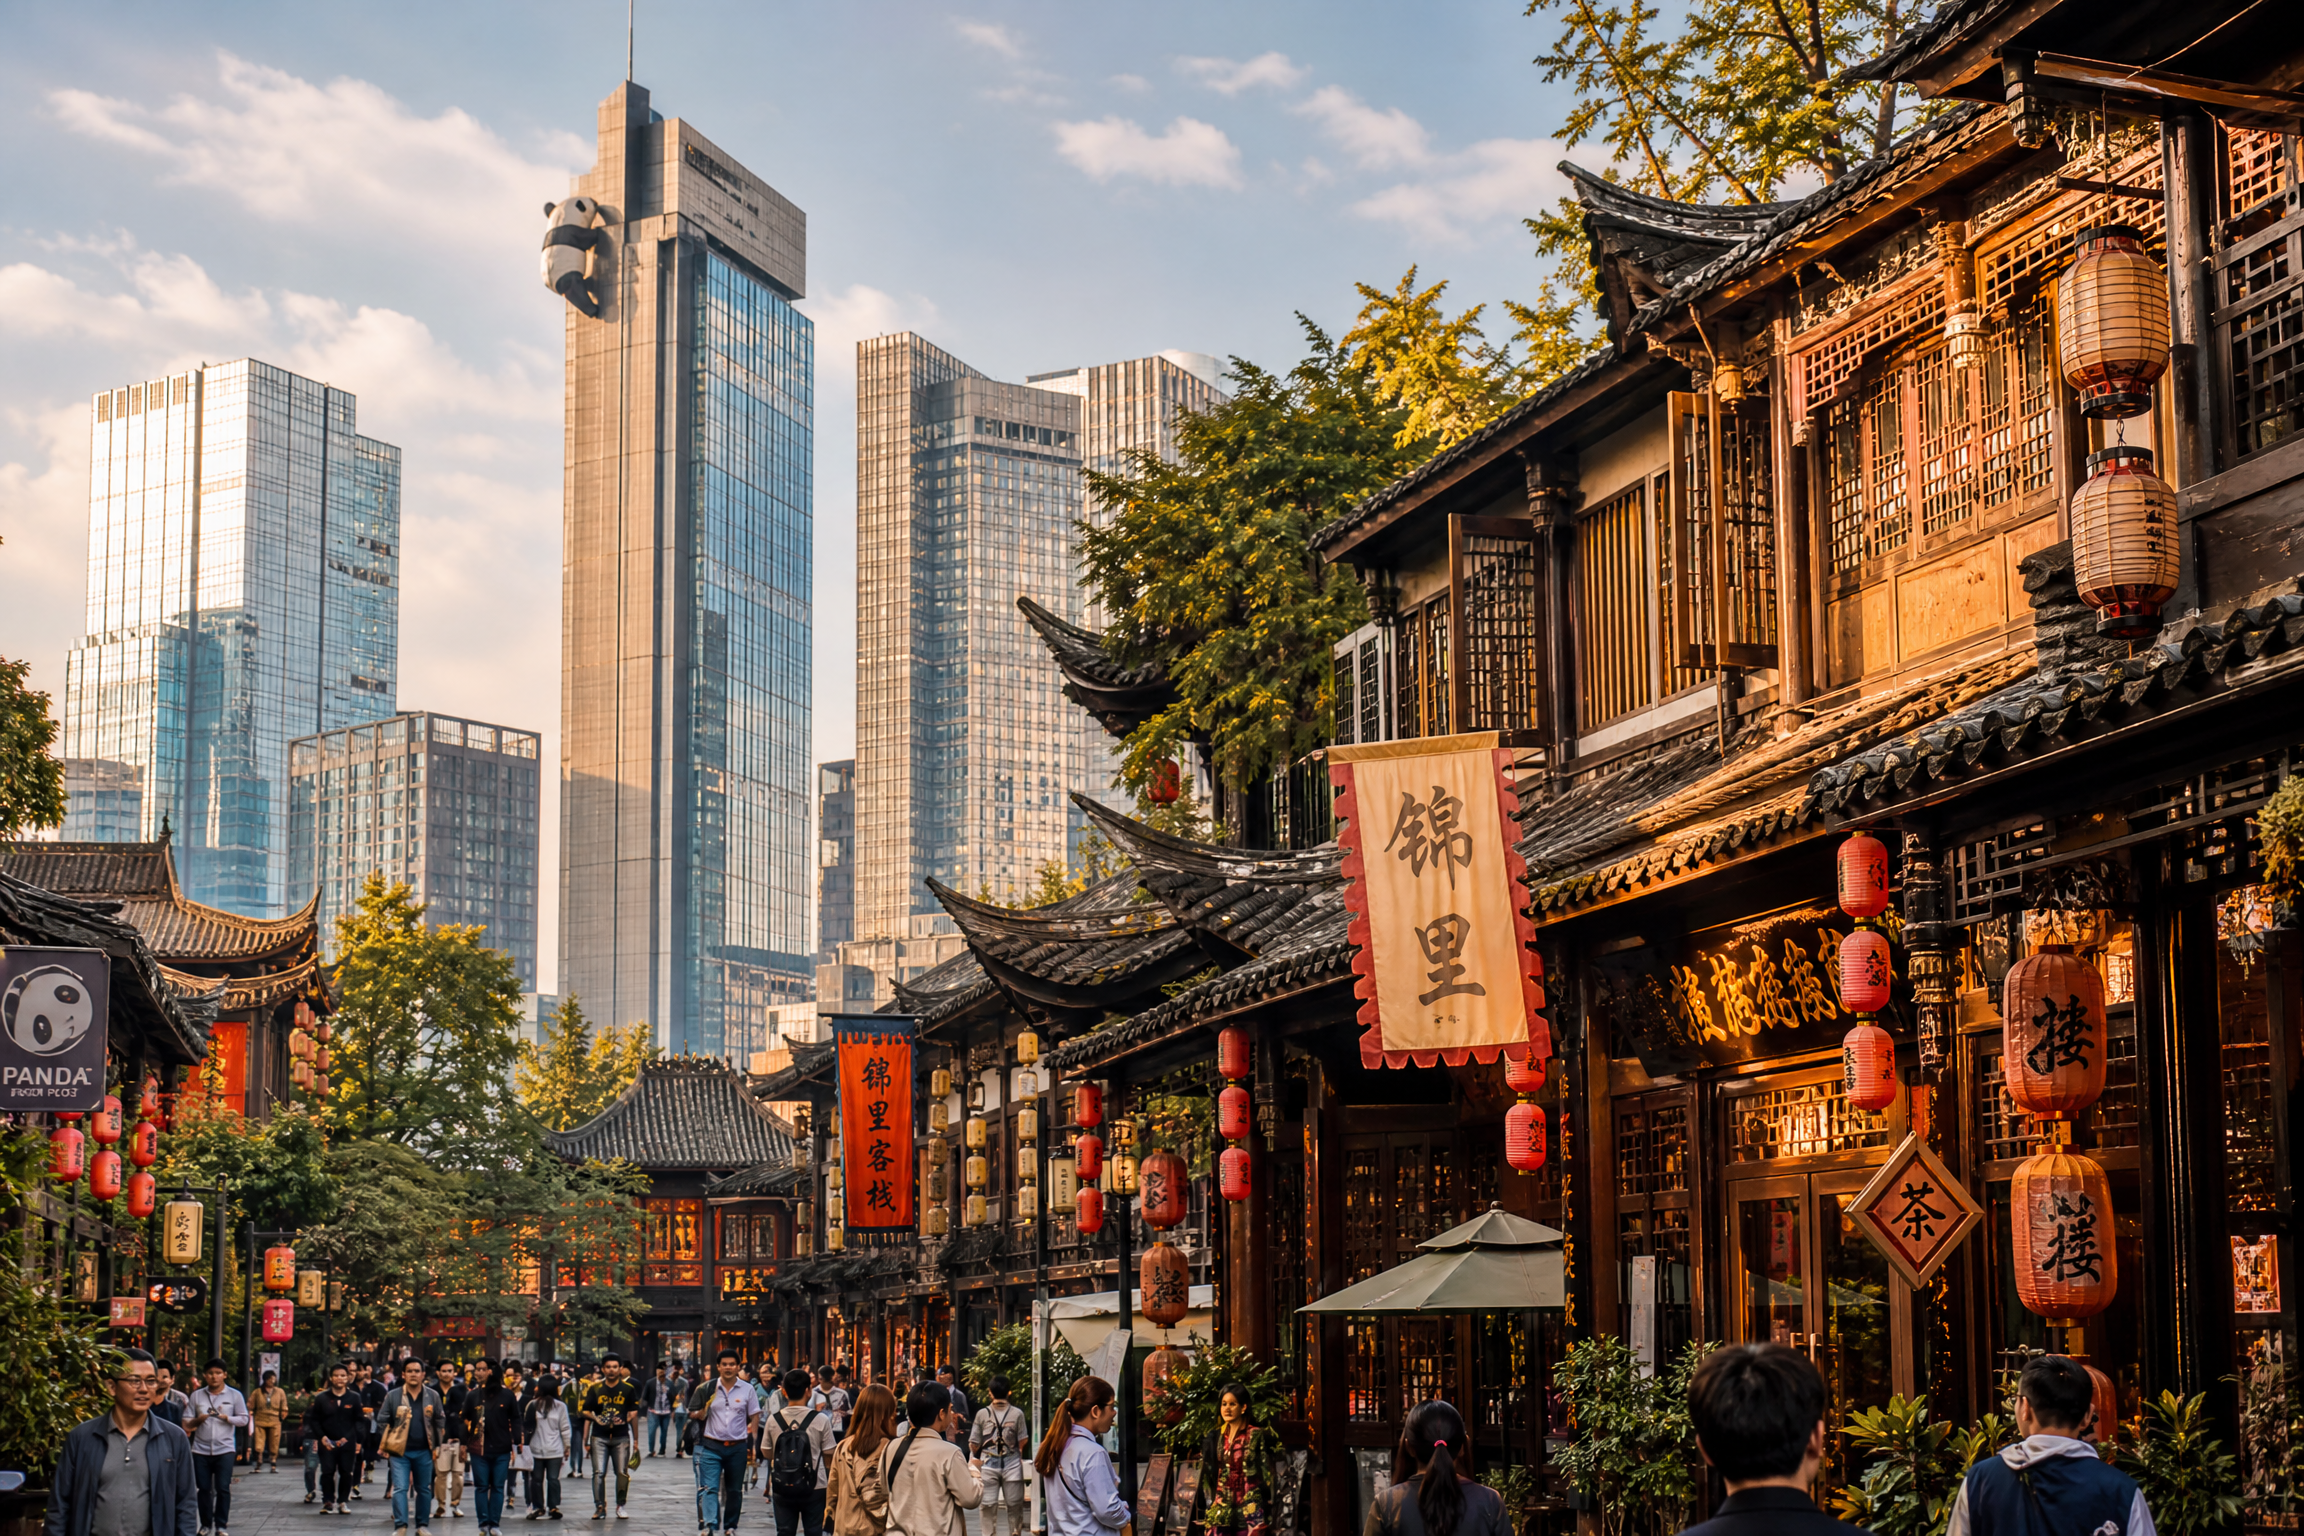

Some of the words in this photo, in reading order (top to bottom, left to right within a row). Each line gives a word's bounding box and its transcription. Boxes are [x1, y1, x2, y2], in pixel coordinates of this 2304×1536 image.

[1384, 785, 1486, 1006] 锦里
[3, 1067, 89, 1086] PANDA
[861, 1057, 897, 1213] 锦里客栈
[1891, 1181, 1947, 1241] 茶
